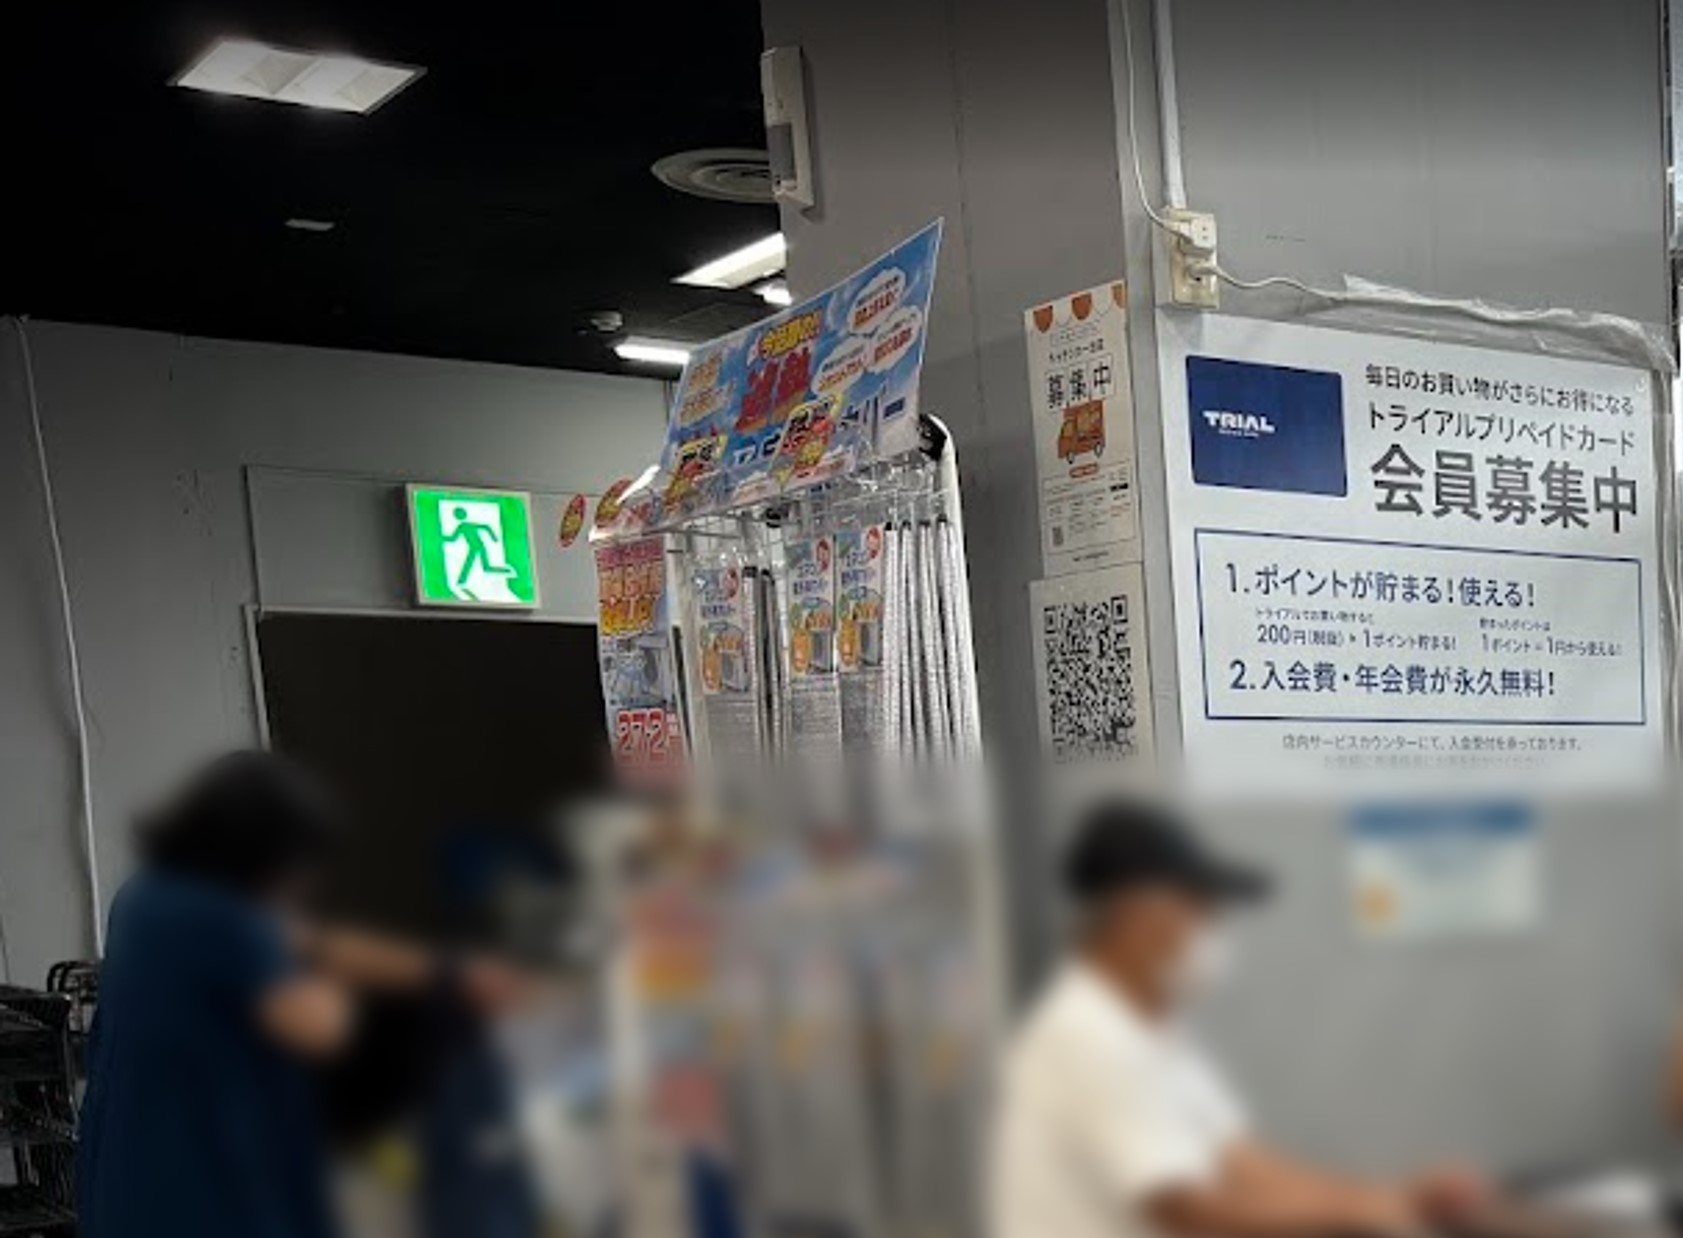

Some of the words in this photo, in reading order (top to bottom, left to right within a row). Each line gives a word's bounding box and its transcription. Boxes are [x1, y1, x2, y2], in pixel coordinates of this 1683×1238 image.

[1365, 363, 1634, 418] 毎日のお買い物がさらにお得になる
[1202, 410, 1276, 434] TRIAL
[1368, 401, 1635, 456] トライアルプリペイドカード
[1370, 443, 1638, 534] 会員募集中
